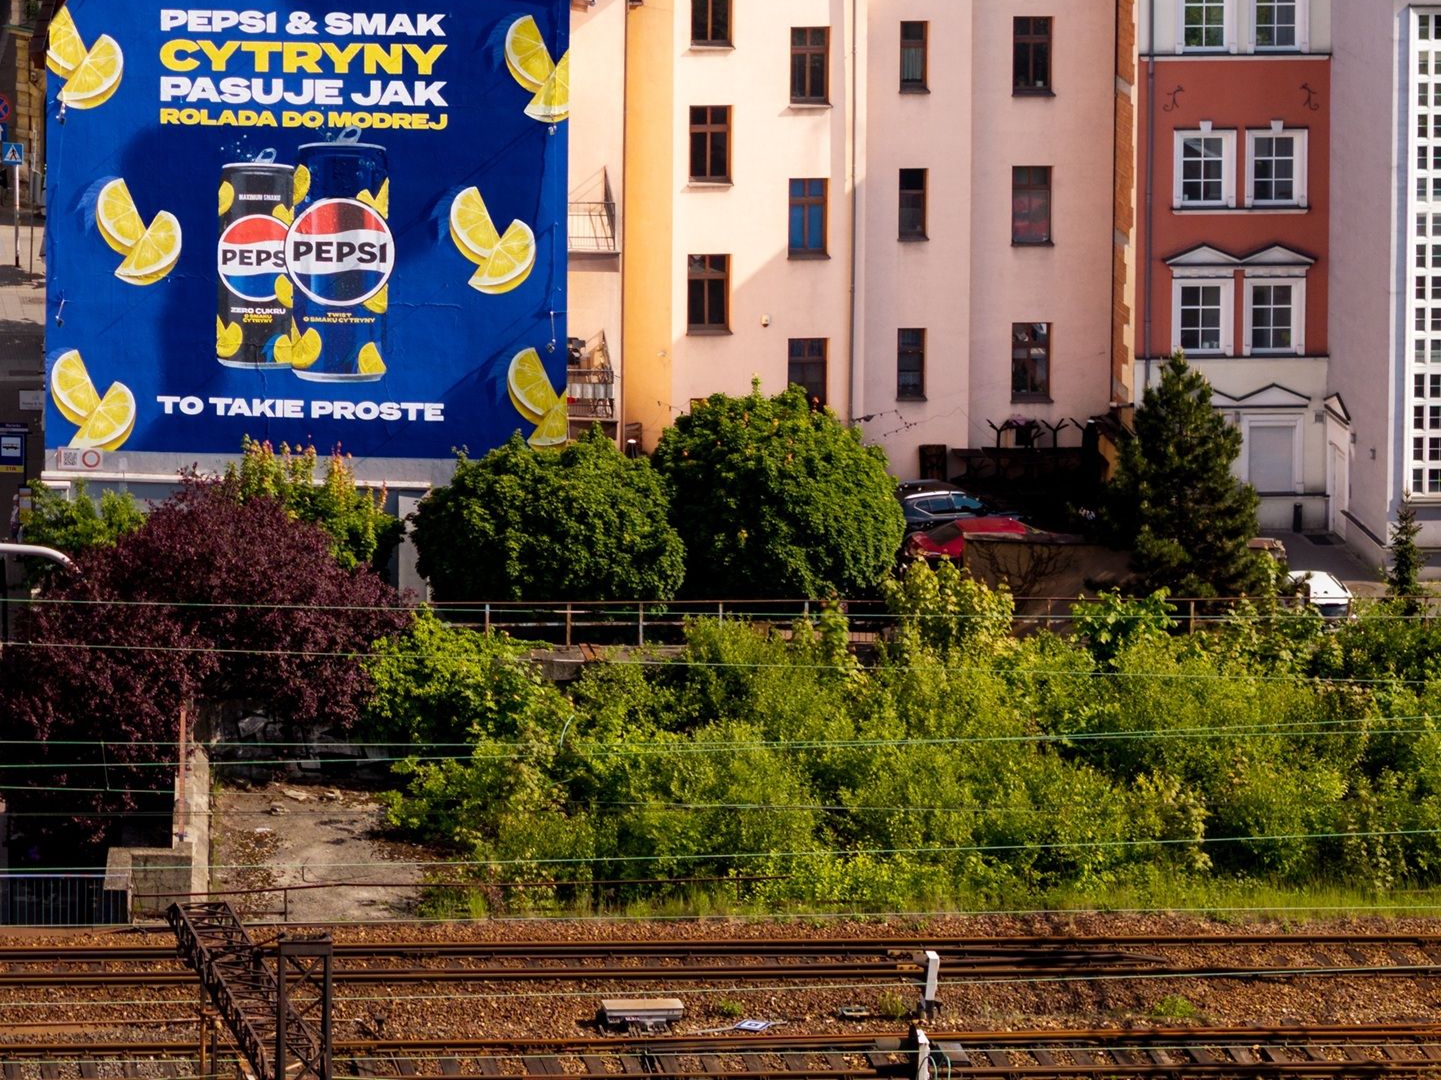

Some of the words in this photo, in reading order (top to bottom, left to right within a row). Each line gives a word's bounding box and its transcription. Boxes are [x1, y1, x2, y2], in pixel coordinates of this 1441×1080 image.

[160, 9, 277, 33] PEPSI
[285, 11, 319, 35] &
[324, 12, 446, 36] SMAK
[159, 39, 448, 75] CYTRYNY
[160, 76, 343, 104] PASUJE
[351, 80, 448, 107] JAK
[160, 108, 278, 128] ROLADA
[282, 110, 325, 128] DO
[328, 111, 448, 131] MODREJ
[293, 241, 387, 264] PEPSI
[157, 396, 204, 415] TO
[209, 397, 304, 418] TAKIE
[311, 400, 445, 422] PROSTE
